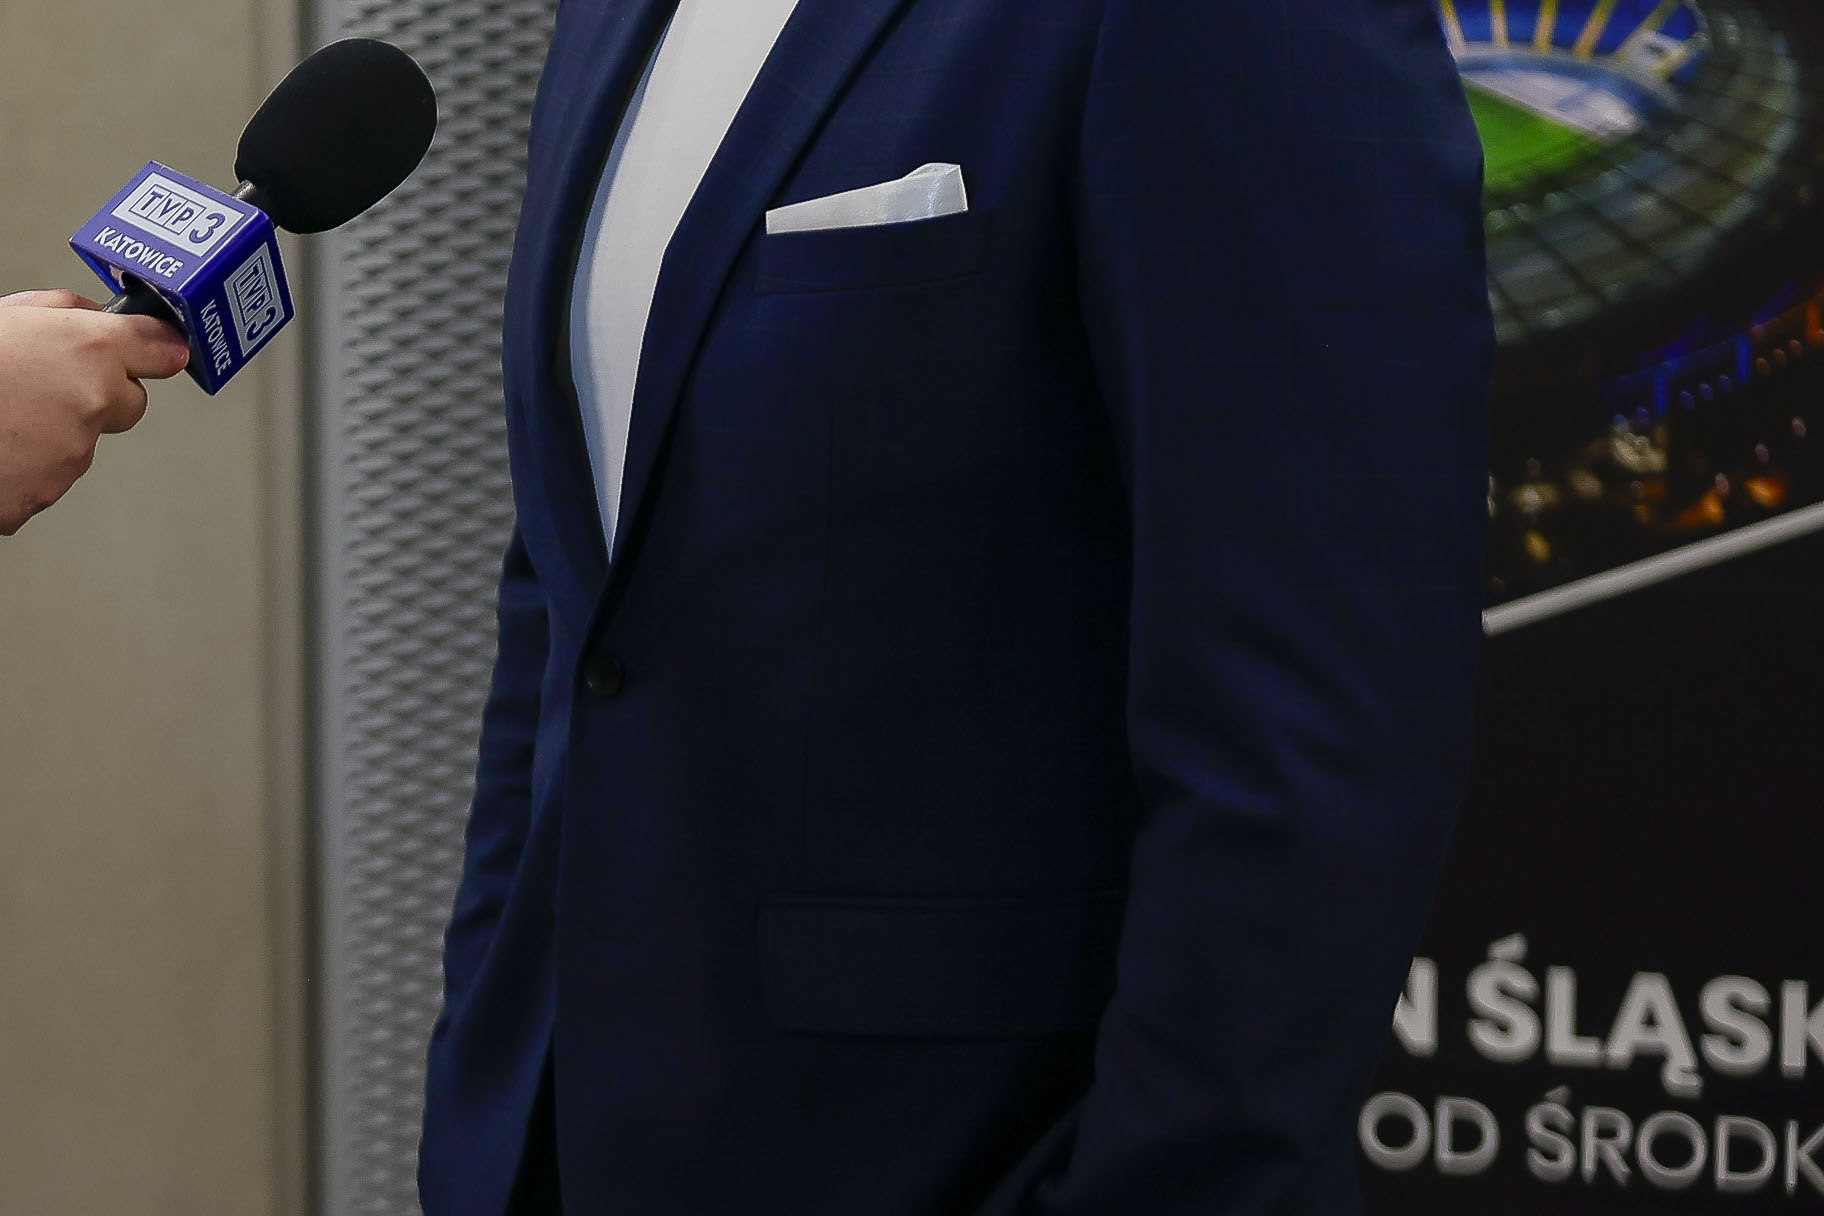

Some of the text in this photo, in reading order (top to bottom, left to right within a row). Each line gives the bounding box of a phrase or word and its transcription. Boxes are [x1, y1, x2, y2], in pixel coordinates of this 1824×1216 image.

[93, 226, 184, 279] KATOWICE
[200, 298, 232, 377] KATOWICE
[1357, 1084, 1824, 1200] OD ŚRODK
